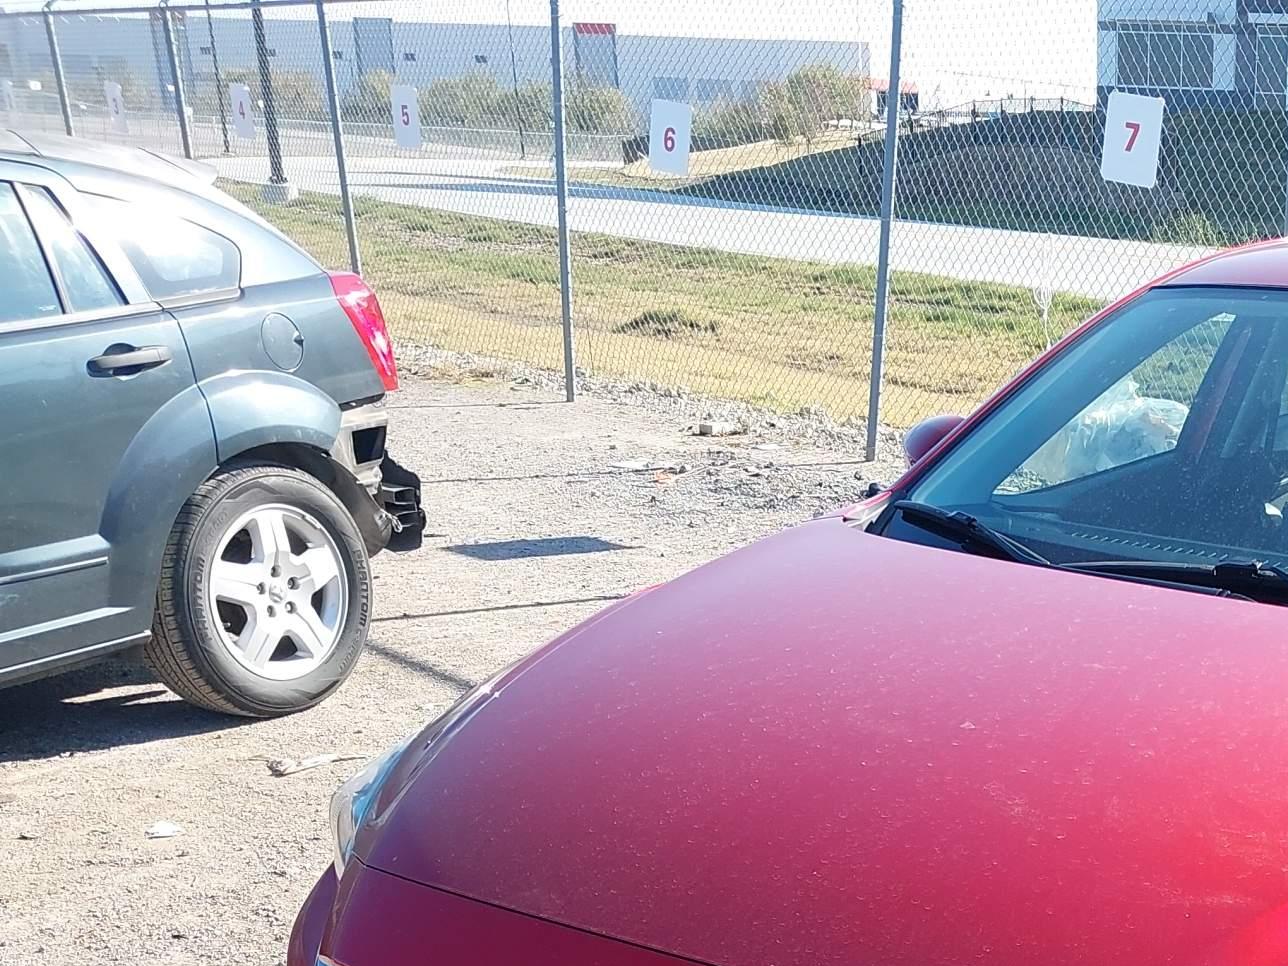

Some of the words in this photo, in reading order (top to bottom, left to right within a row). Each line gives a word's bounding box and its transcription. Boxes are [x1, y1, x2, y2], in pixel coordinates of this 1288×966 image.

[239, 101, 245, 120] 4
[401, 104, 410, 126] 5
[663, 127, 676, 152] 6
[1125, 122, 1140, 152] 7
